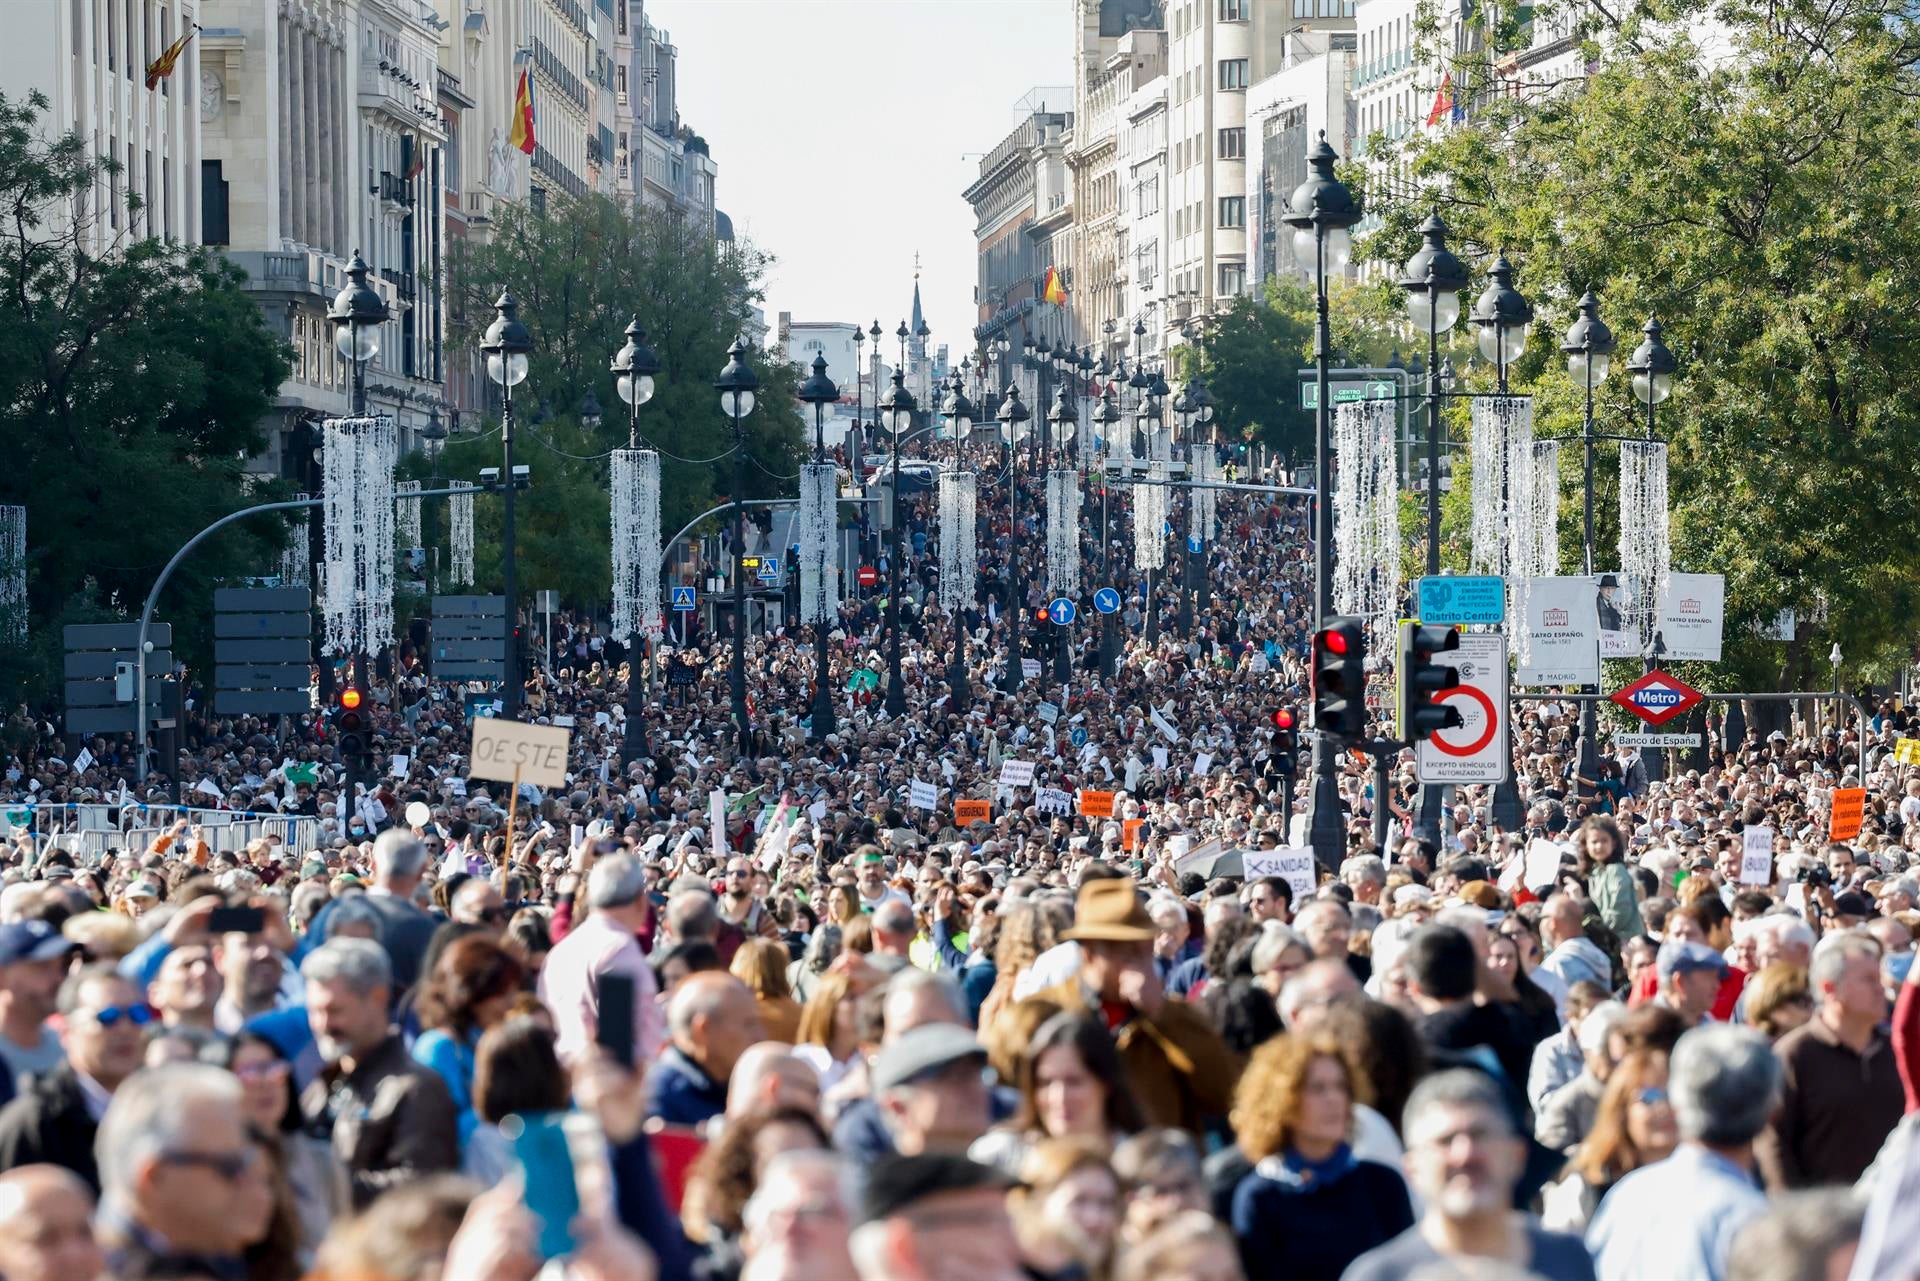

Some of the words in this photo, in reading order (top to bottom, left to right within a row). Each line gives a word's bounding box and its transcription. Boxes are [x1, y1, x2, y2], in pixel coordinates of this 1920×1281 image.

[1425, 612, 1462, 621] Distrito
[1463, 611, 1500, 620] Centro
[1554, 630, 1584, 638] ESPAÑOL
[1638, 691, 1677, 704] Metro
[1618, 736, 1648, 744] Banco
[1649, 736, 1661, 744] de
[1663, 736, 1696, 747] España
[476, 736, 565, 770] OESTE
[1266, 857, 1311, 875] SANIDAD
